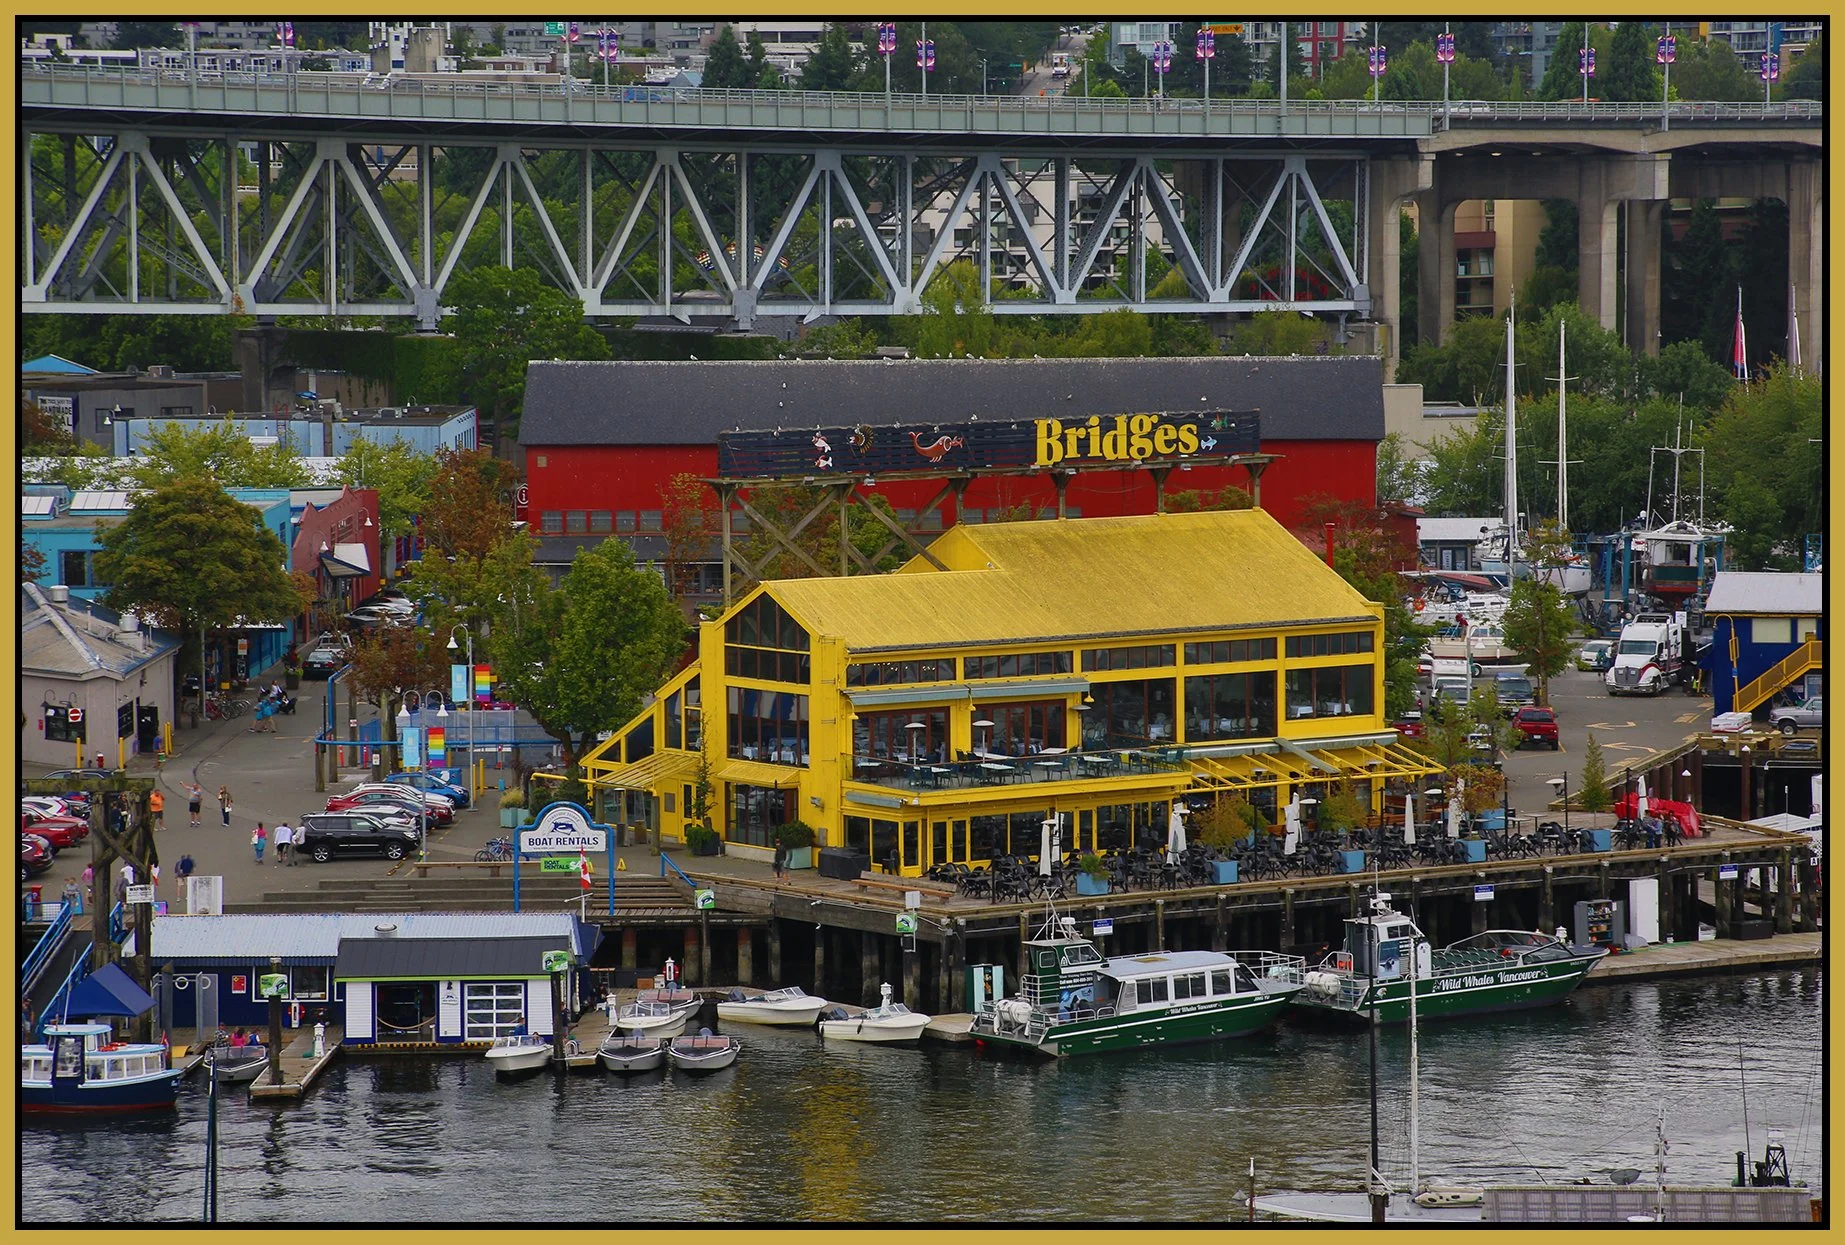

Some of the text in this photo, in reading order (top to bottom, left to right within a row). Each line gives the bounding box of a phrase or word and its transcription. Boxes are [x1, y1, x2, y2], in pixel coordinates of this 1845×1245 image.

[1034, 413, 1199, 466] Bridges
[528, 836, 599, 846] BOAT RENTALS
[1439, 970, 1541, 991] Wild Whales Vancouver
